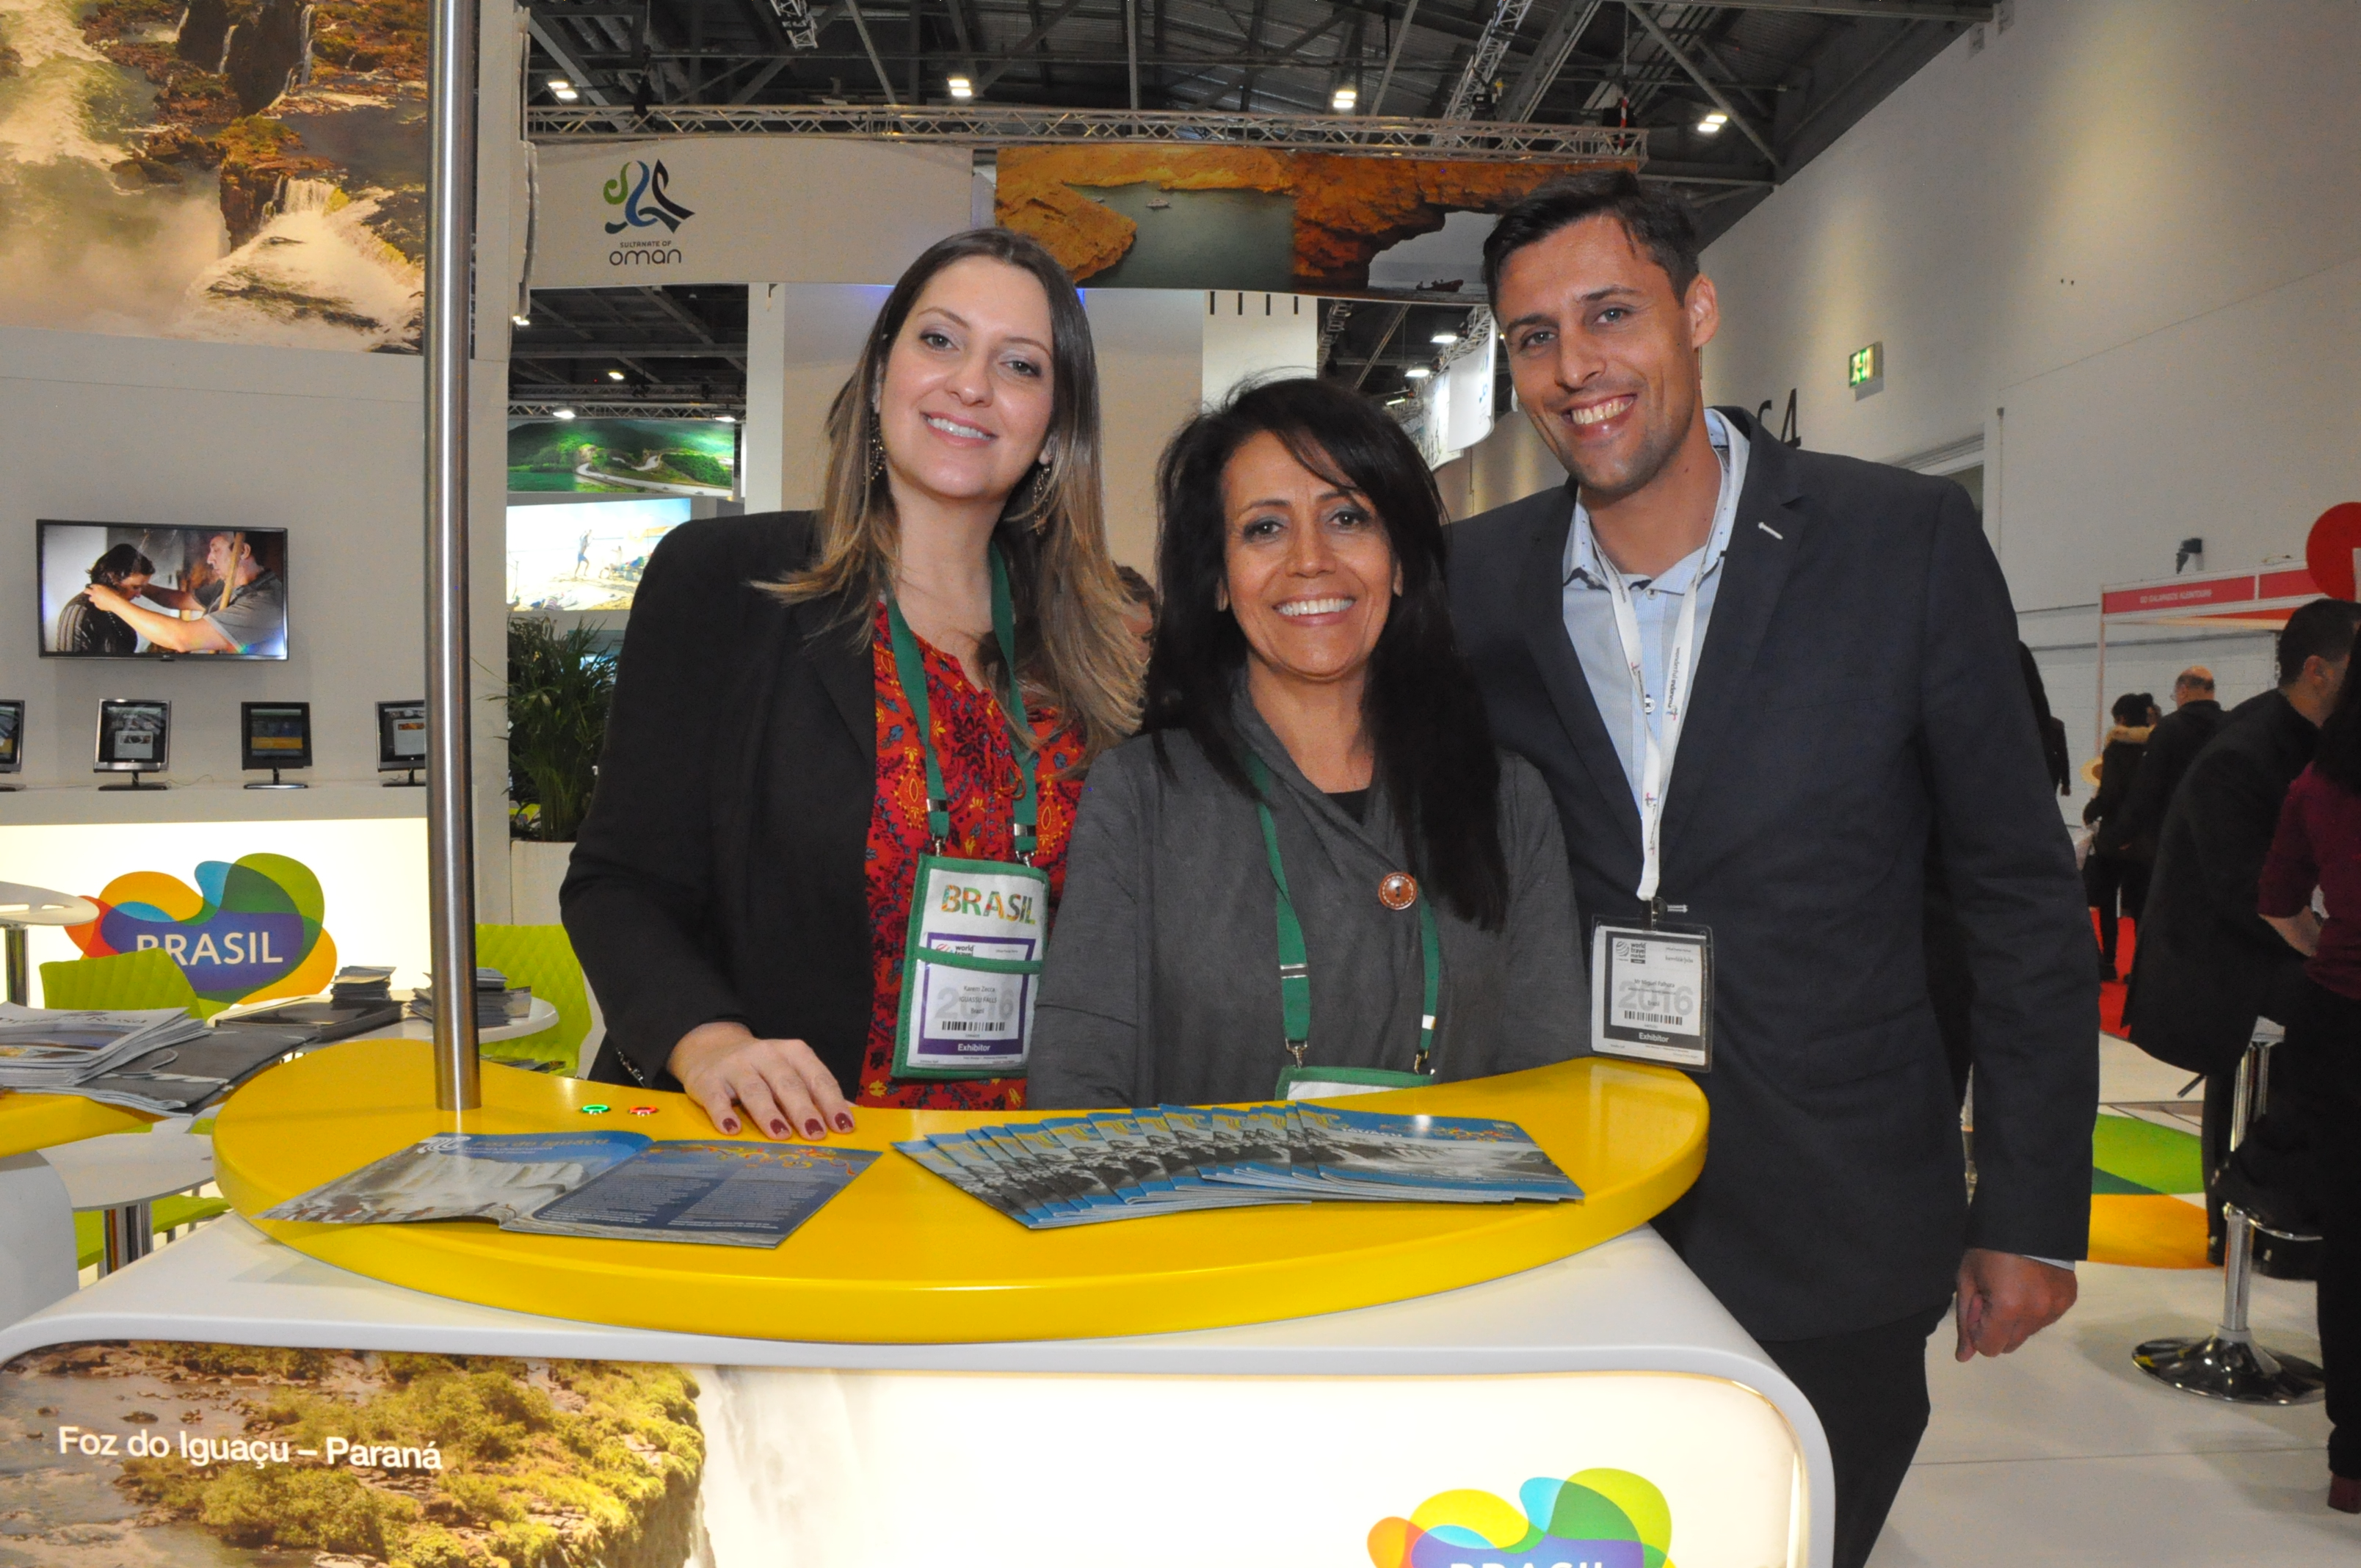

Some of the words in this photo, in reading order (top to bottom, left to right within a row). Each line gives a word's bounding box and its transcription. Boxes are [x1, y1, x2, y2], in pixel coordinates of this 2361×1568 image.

[609, 249, 681, 266] oman
[1672, 647, 1680, 679] wonderful
[941, 885, 1036, 925] BRASIL
[1619, 981, 1693, 1015] 2016
[957, 1043, 990, 1052] Exhibitor
[1639, 1033, 1669, 1043] Exhibitor
[59, 1426, 119, 1456] Foz
[128, 1429, 170, 1457] do
[181, 1431, 289, 1469] Iguaçu
[327, 1437, 443, 1470] Paraná
